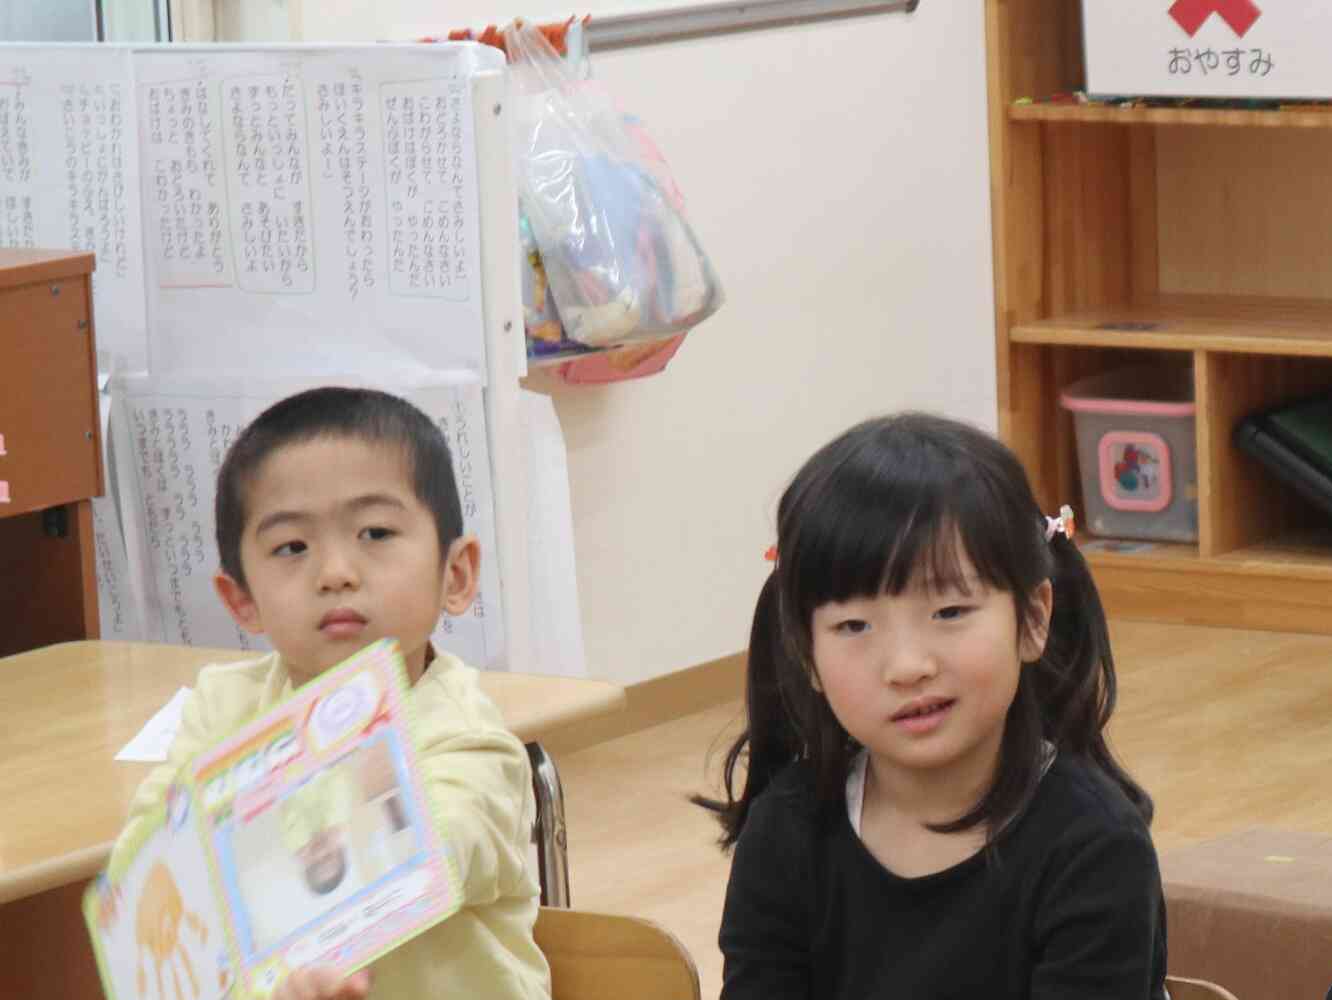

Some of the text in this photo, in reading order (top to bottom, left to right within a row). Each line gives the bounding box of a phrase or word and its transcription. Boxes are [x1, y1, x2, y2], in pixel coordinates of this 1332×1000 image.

[1168, 47, 1275, 76] おやすみ
[148, 87, 163, 145] おばけは
[164, 87, 180, 145] ちょっと
[247, 85, 269, 186] ずっとみんなと
[265, 85, 287, 200] もっといっしょに
[180, 87, 206, 259] きみのきもち わかったよ
[229, 85, 259, 273] さよならなんて さみしいよ
[402, 96, 422, 288] おばけはぼくが やったんだ
[207, 202, 224, 273] ありがとう
[292, 199, 309, 273] すきだから
[391, 200, 407, 273] やったんだ
[422, 201, 436, 288] ごめんなさい
[437, 201, 451, 288] ごめんなさい
